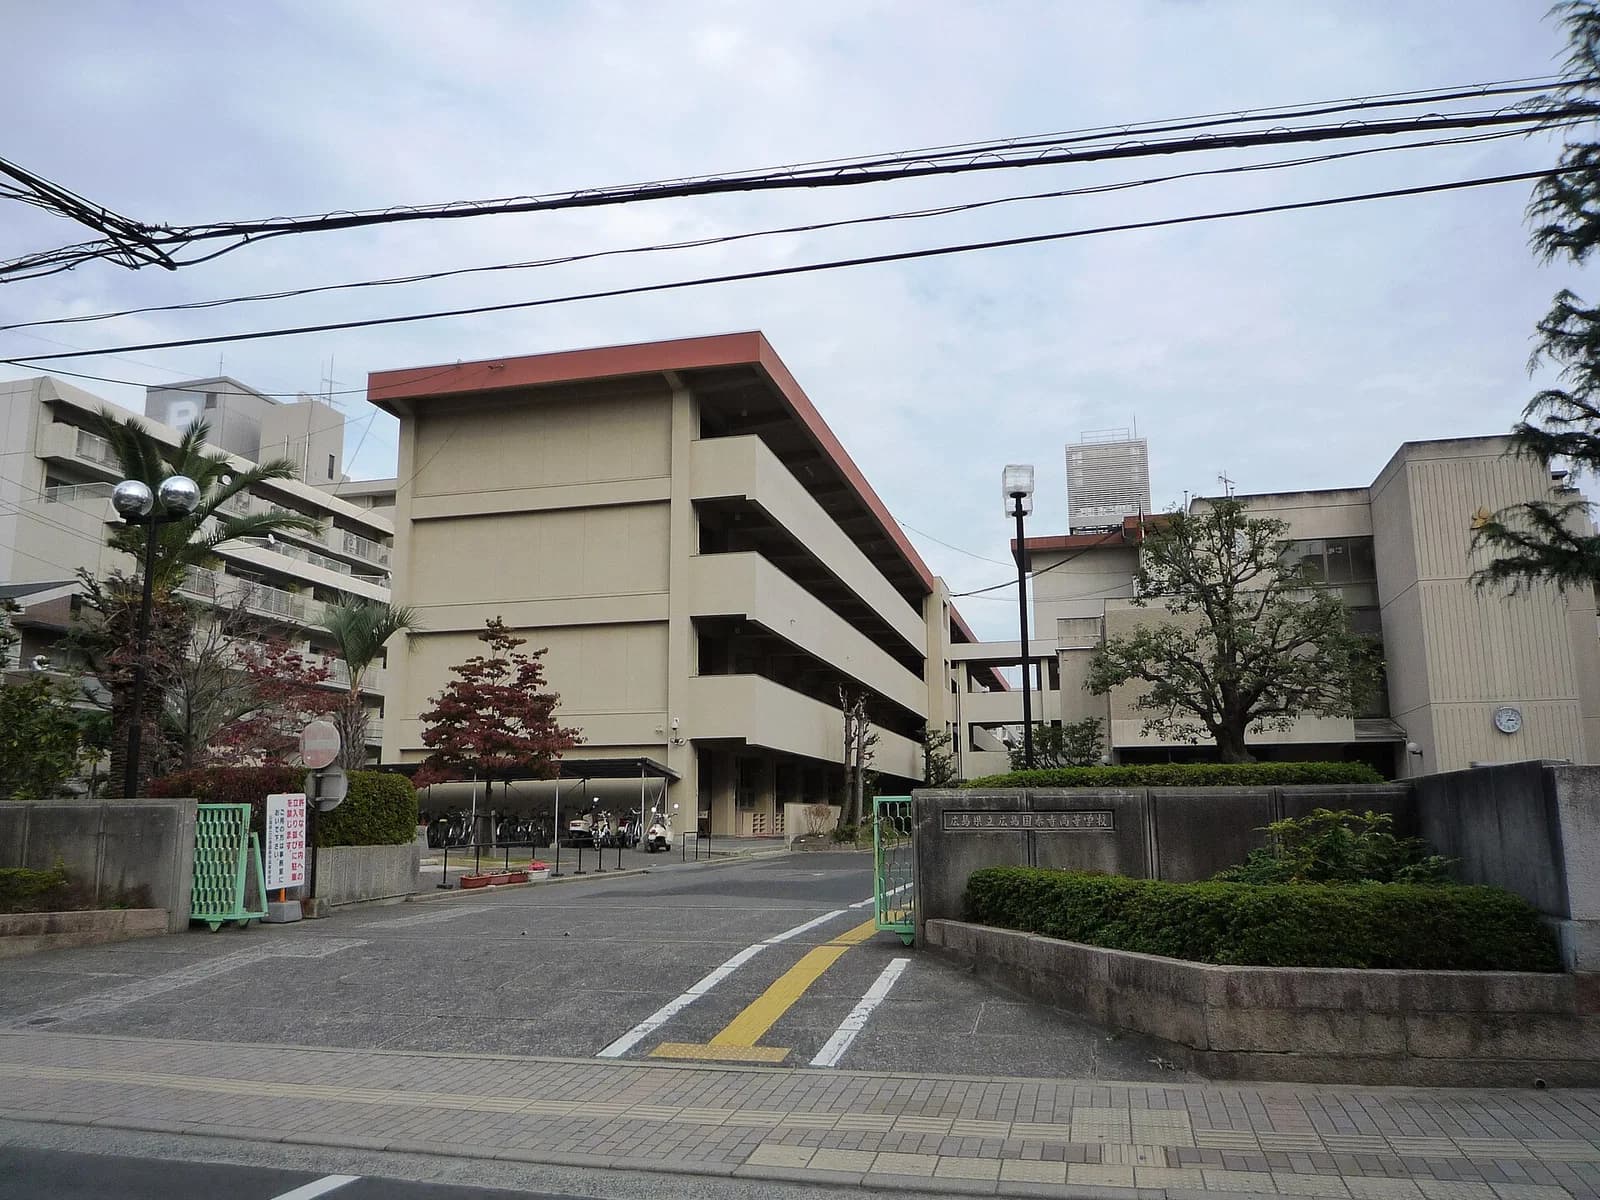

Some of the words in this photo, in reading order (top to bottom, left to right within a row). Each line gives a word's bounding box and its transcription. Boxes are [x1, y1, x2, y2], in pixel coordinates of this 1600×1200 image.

[296, 799, 304, 881] 許可なく校内への
